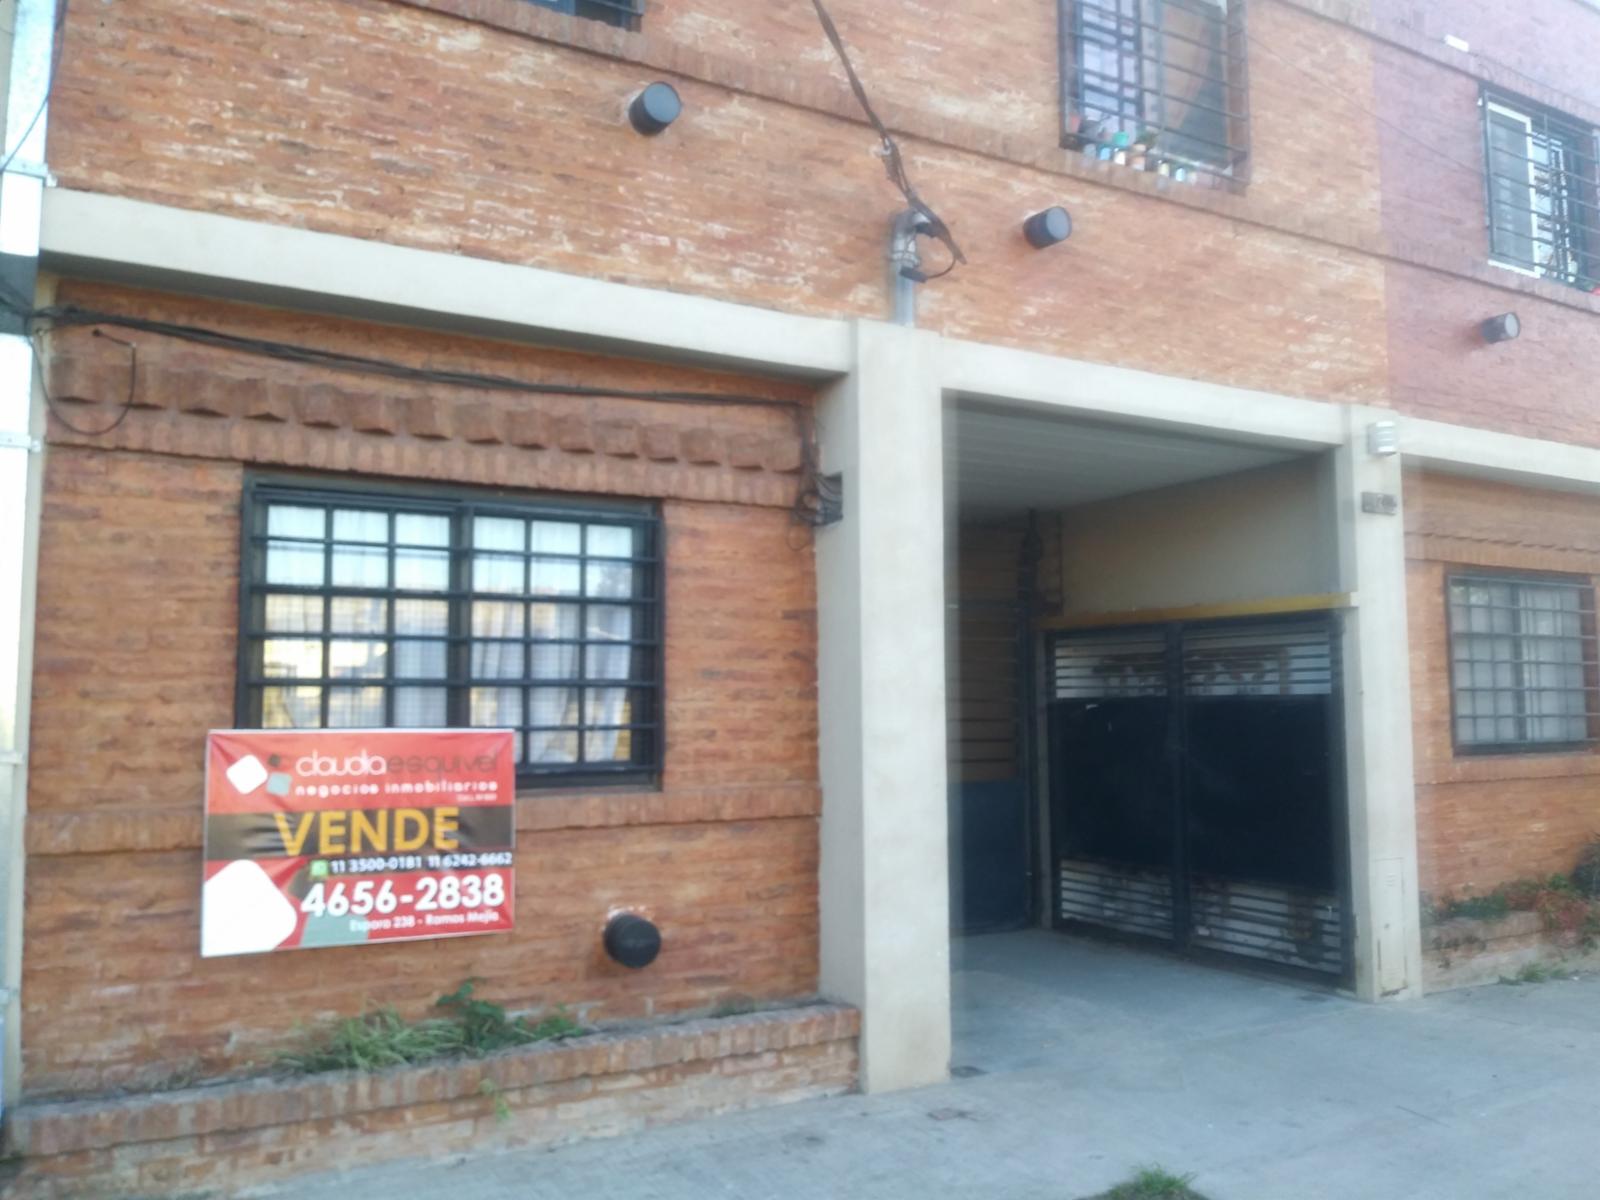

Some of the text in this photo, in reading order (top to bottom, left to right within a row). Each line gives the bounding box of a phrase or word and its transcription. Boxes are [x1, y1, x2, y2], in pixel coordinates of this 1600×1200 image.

[295, 780, 499, 798] negocios inmobiliarios
[273, 807, 460, 856] VENDE
[331, 860, 346, 873] 11
[300, 873, 506, 918] 4656-2838
